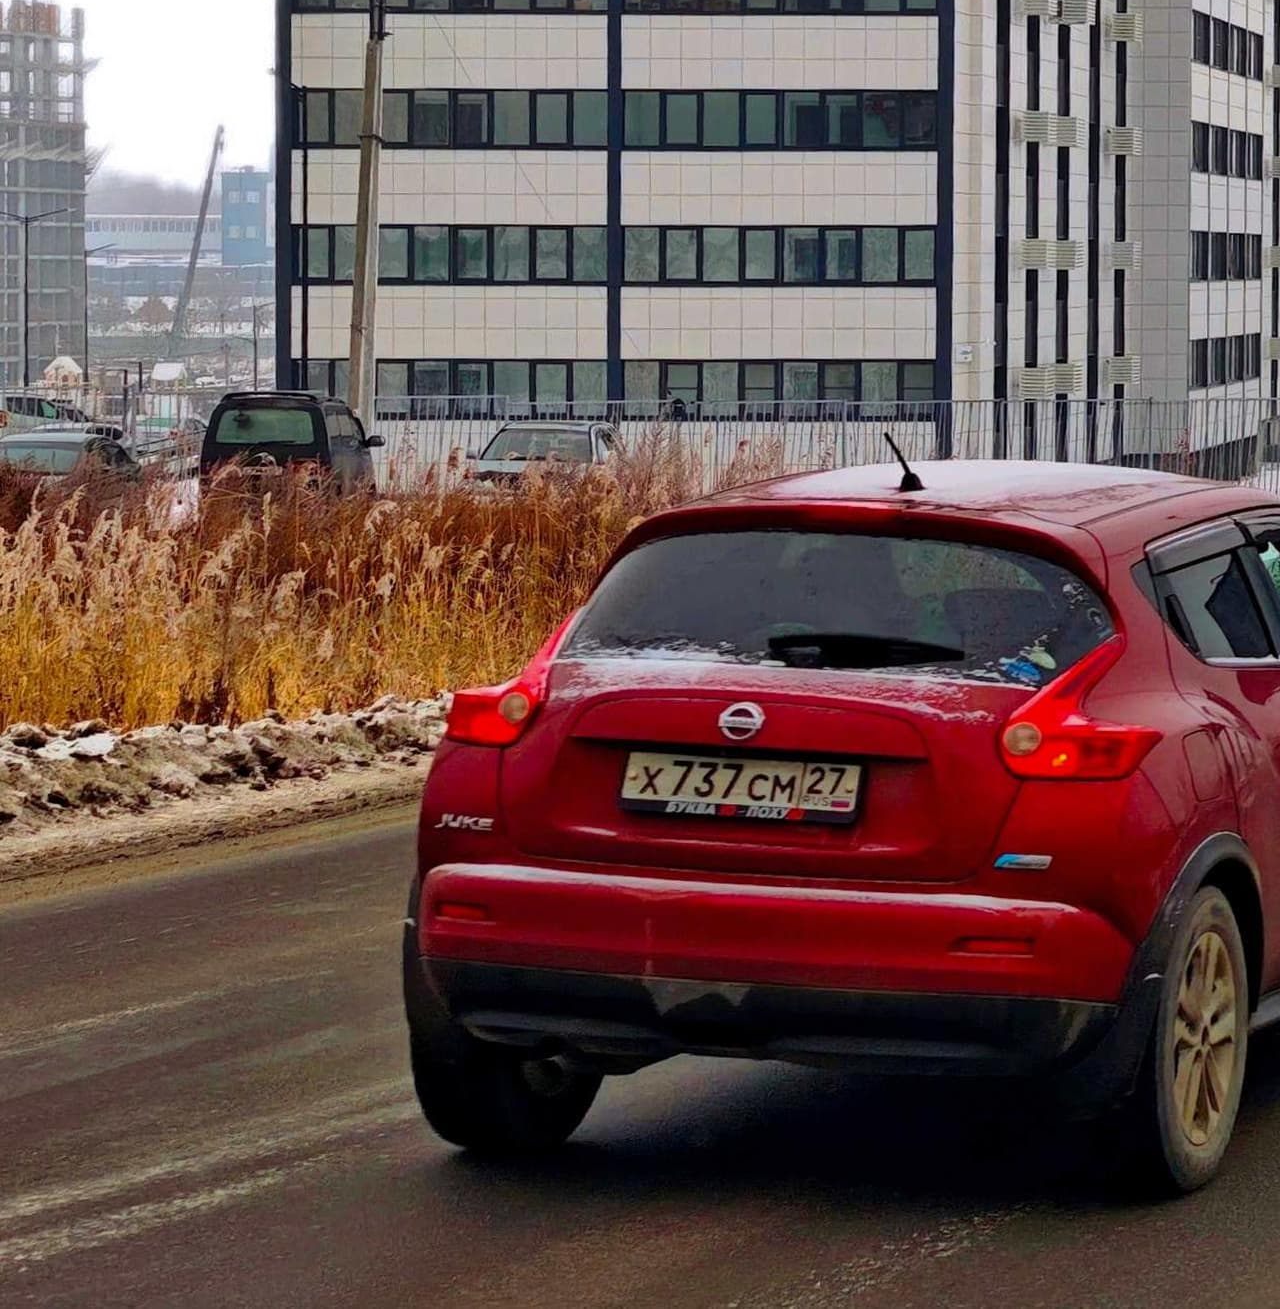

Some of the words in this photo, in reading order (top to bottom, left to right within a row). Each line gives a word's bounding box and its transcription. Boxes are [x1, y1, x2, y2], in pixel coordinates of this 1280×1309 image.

[806, 767, 847, 795] 27
[664, 801, 716, 815] БУКВА
[802, 795, 831, 807] RUS
[434, 813, 495, 831] JUKE
